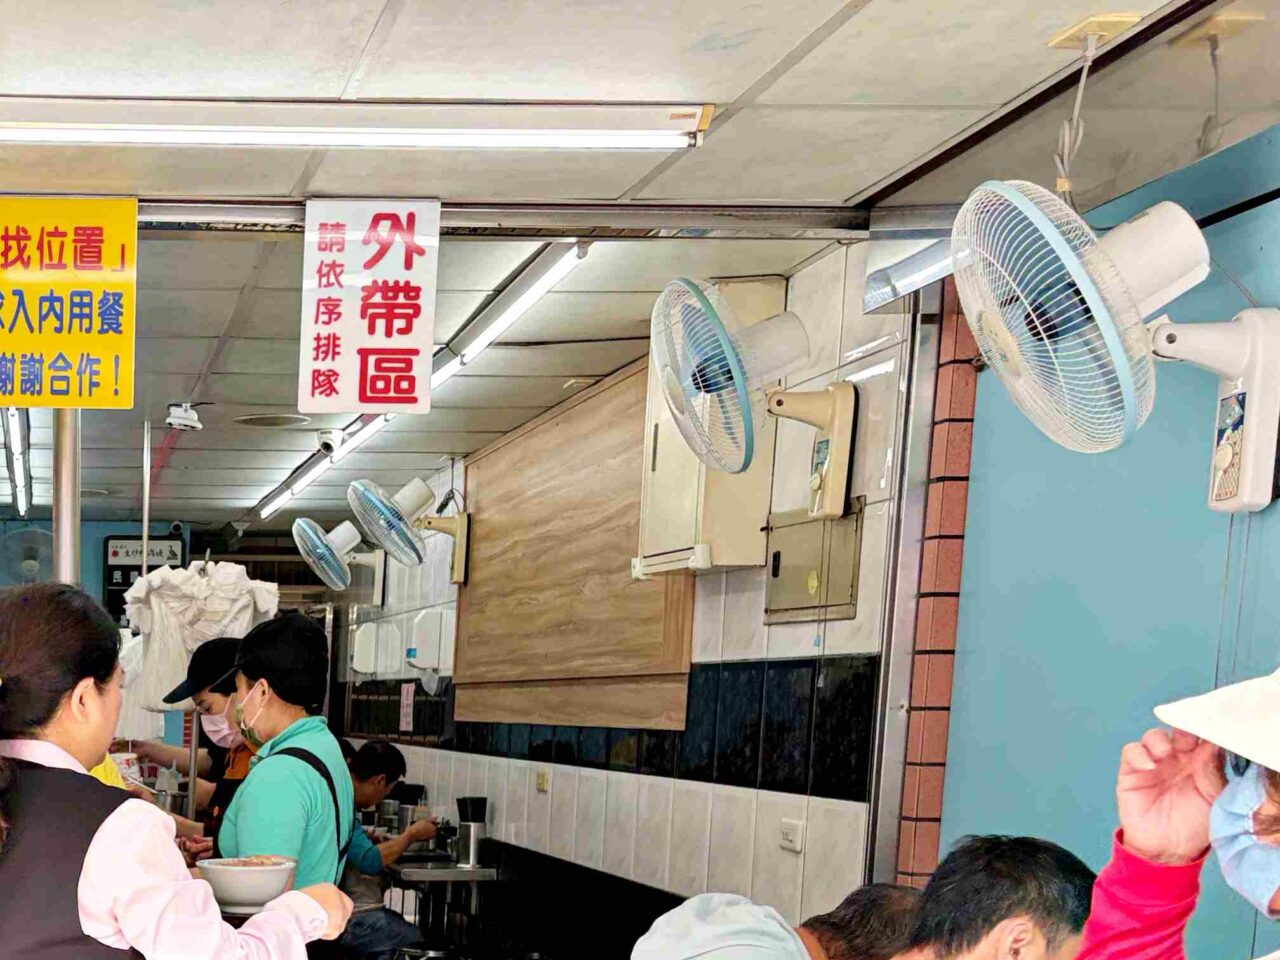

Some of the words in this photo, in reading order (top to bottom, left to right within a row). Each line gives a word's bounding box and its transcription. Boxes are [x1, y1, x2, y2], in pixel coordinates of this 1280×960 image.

[310, 221, 347, 399] 請依序排隊
[357, 211, 426, 405] 外帶區
